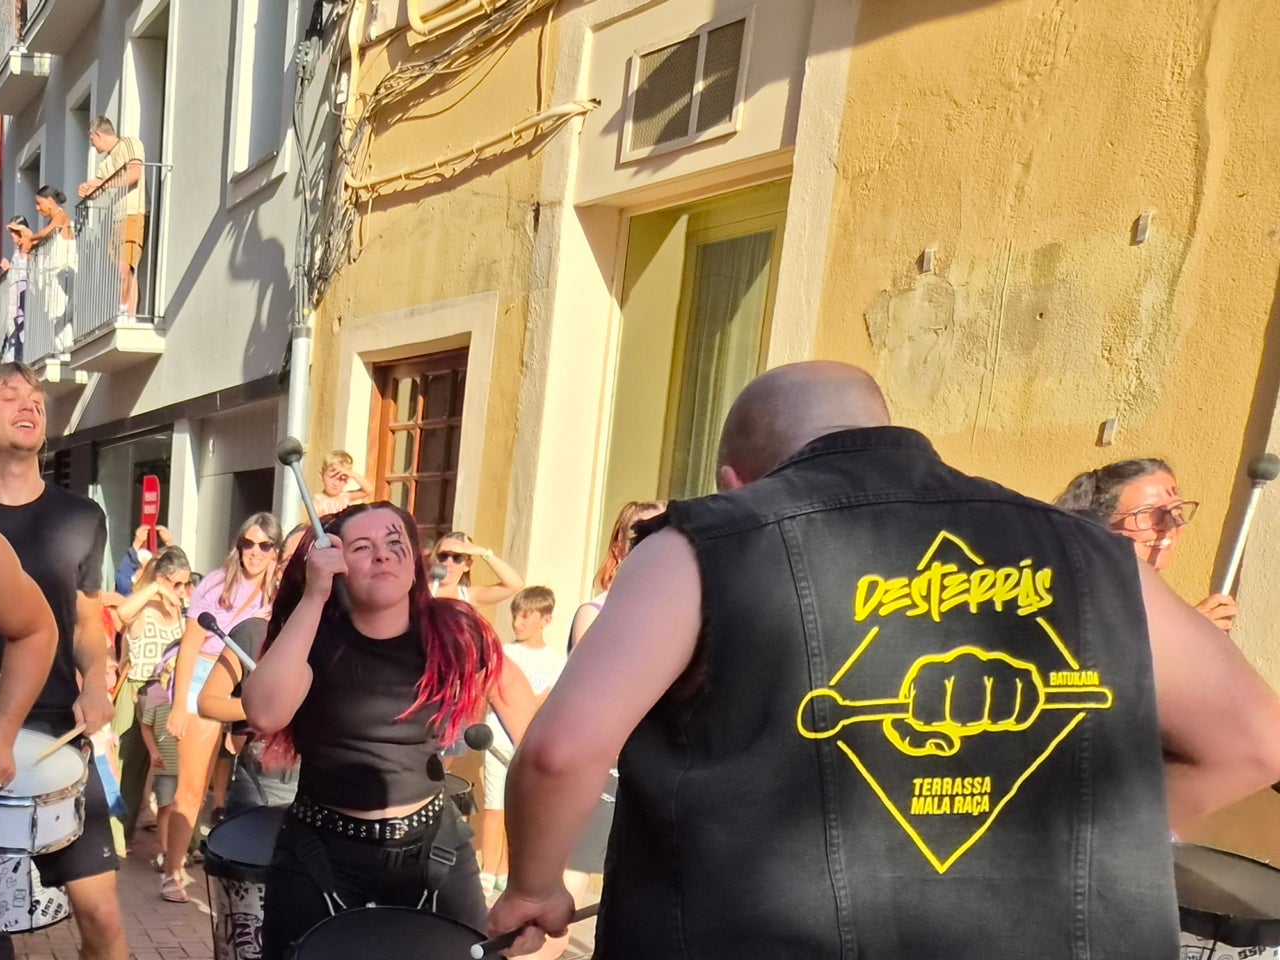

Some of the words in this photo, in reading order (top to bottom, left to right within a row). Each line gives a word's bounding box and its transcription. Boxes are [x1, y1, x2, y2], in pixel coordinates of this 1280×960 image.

[854, 558, 1054, 623] DESTERRÁS
[1049, 671, 1100, 686] BATUKADA
[912, 776, 991, 796] TERRASSA
[910, 796, 951, 815] MALA
[953, 795, 990, 816] RAÇA
